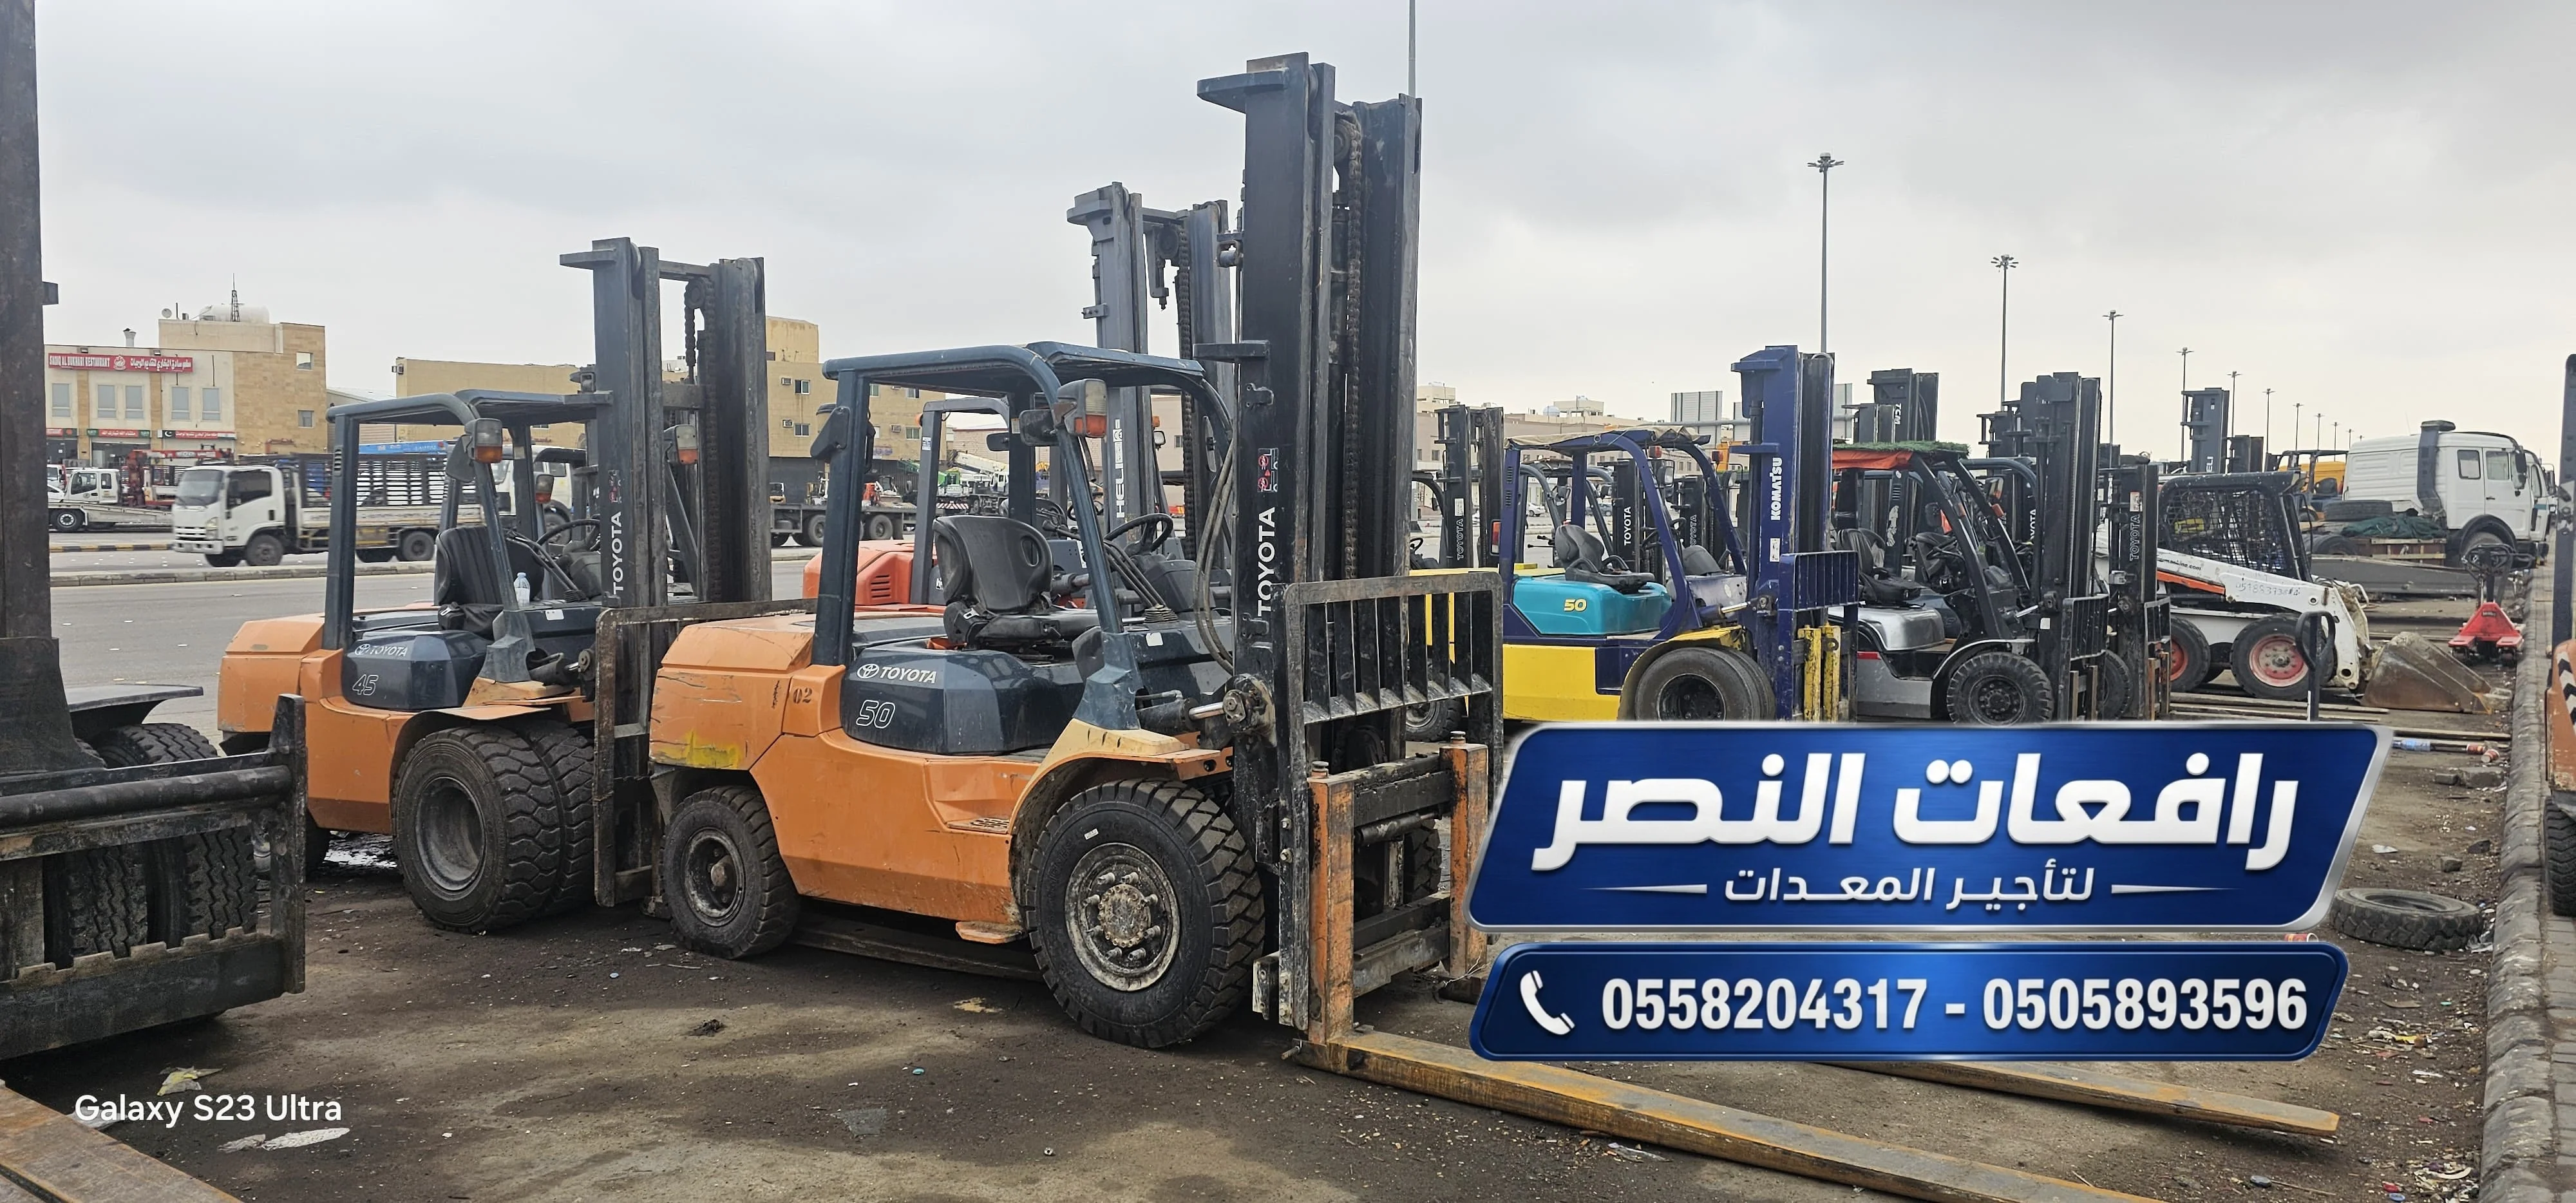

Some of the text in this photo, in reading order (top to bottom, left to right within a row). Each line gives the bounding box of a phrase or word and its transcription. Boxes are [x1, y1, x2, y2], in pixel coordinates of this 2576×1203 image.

[62, 355, 67, 366] AL
[85, 357, 110, 367] RESTAURANT
[1115, 462, 1125, 518] HELI
[1770, 457, 1783, 520] KOMATSU
[1624, 506, 1632, 546] TOYOTA
[2129, 514, 2141, 562] TOYOTA
[612, 511, 623, 595] TOYOTA
[1258, 507, 1275, 617] TOYOTA
[1564, 599, 1587, 611] 50
[370, 645, 408, 657] TOYOTA
[352, 674, 379, 696] 45
[880, 666, 936, 684] TOYOTA
[793, 687, 813, 704] 02
[856, 699, 895, 728] 50
